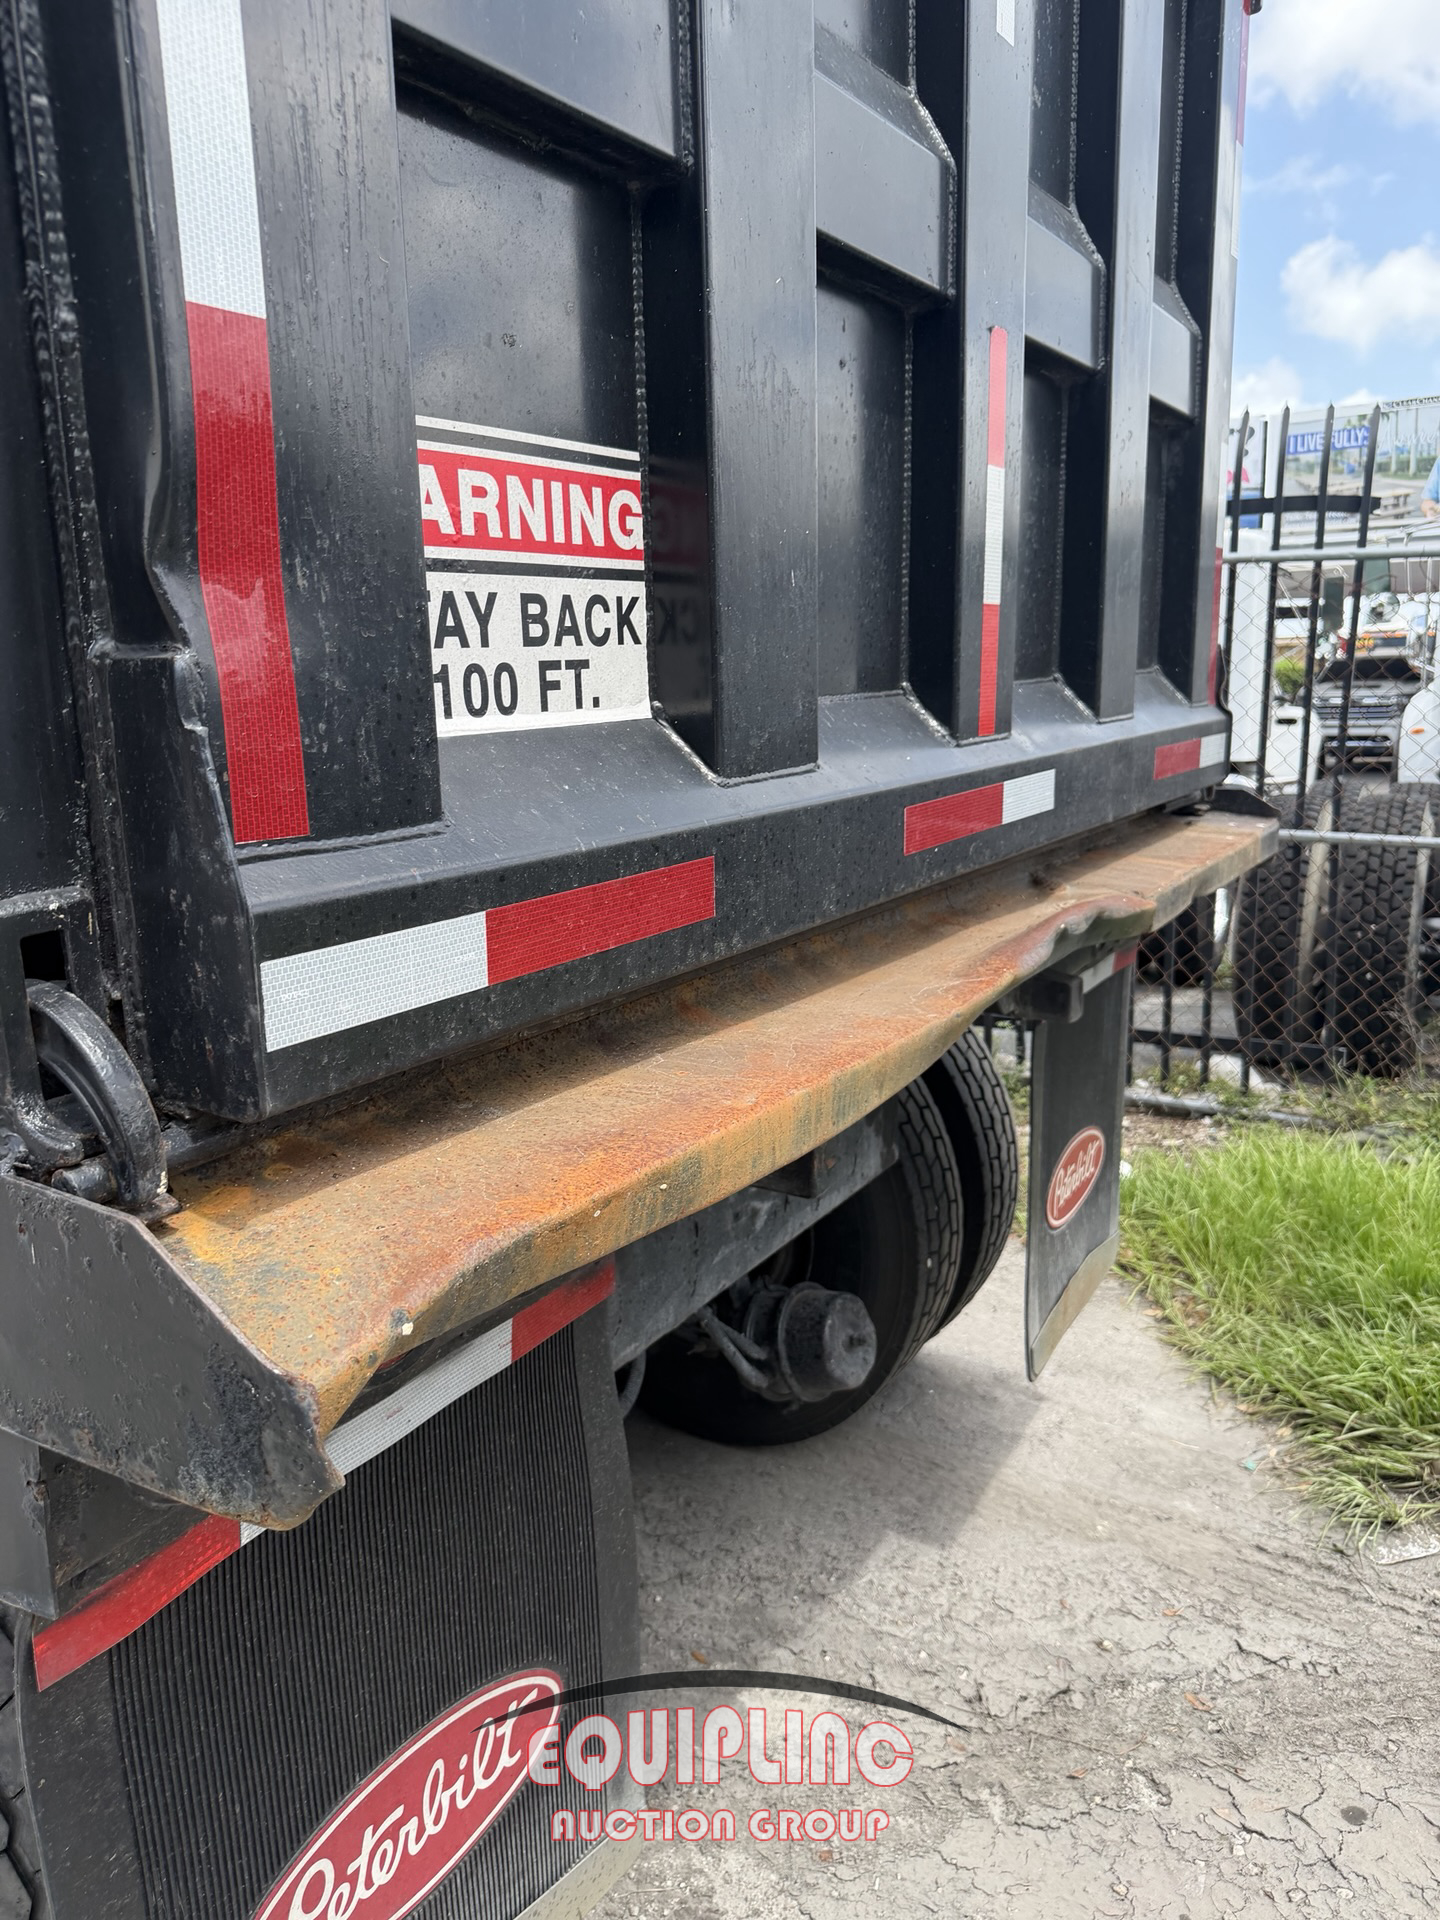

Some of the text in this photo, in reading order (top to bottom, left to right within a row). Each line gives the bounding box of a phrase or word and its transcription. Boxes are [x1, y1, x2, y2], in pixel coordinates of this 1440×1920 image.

[1297, 433, 1325, 452] LIVE
[417, 463, 643, 551] ARNING
[427, 590, 498, 649] AY
[519, 592, 642, 648] BACK
[433, 659, 601, 720] 100 FT.
[288, 1687, 538, 1920] Peterbilt
